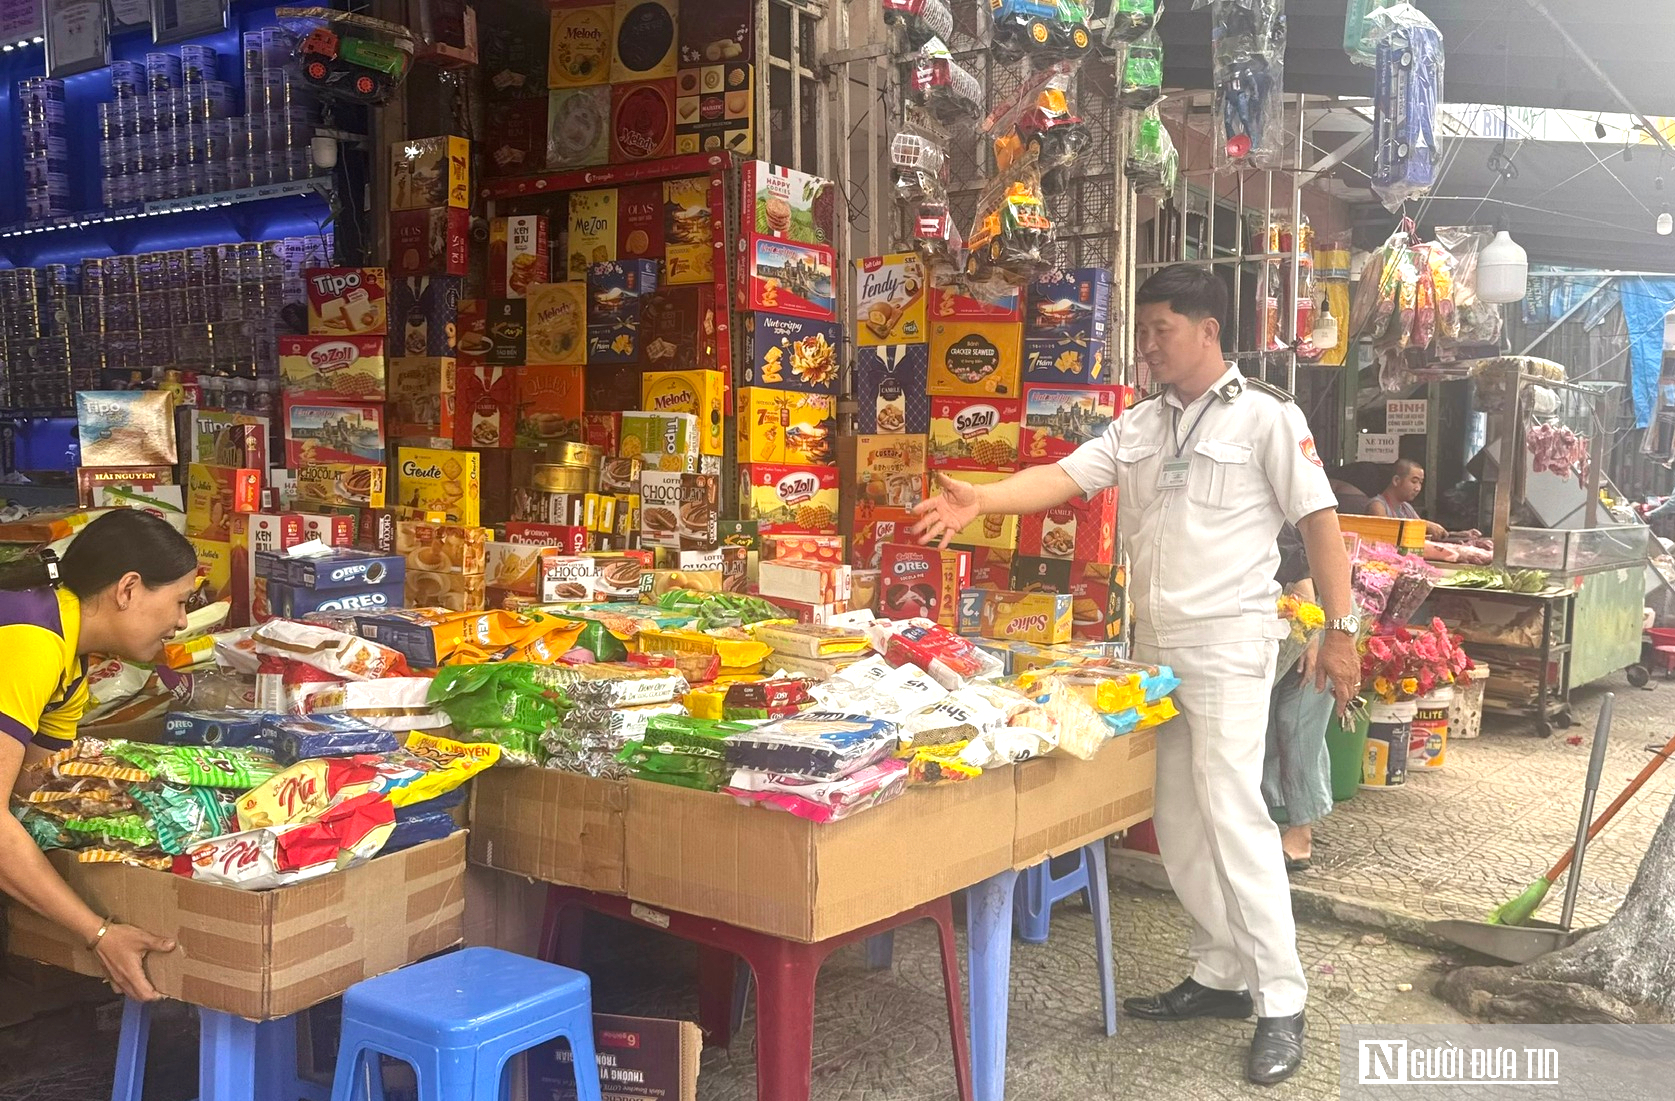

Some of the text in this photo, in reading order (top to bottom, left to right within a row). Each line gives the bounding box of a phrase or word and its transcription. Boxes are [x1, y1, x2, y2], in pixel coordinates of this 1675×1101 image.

[312, 273, 360, 296] Tipo
[862, 269, 905, 302] fendy
[950, 348, 995, 356] CRACKER SEAWEED
[654, 390, 692, 411] Melody
[957, 411, 994, 431] SoZoll
[664, 417, 679, 454] Tipo
[643, 484, 705, 502] CHOCOLAT
[779, 478, 815, 497] SoZoll
[509, 534, 564, 552] ChocoPie
[331, 565, 367, 582] OREO
[547, 566, 604, 577] CHOCOLAT
[894, 561, 929, 574] OREO
[318, 593, 386, 611] OREO
[166, 720, 193, 731] OREO
